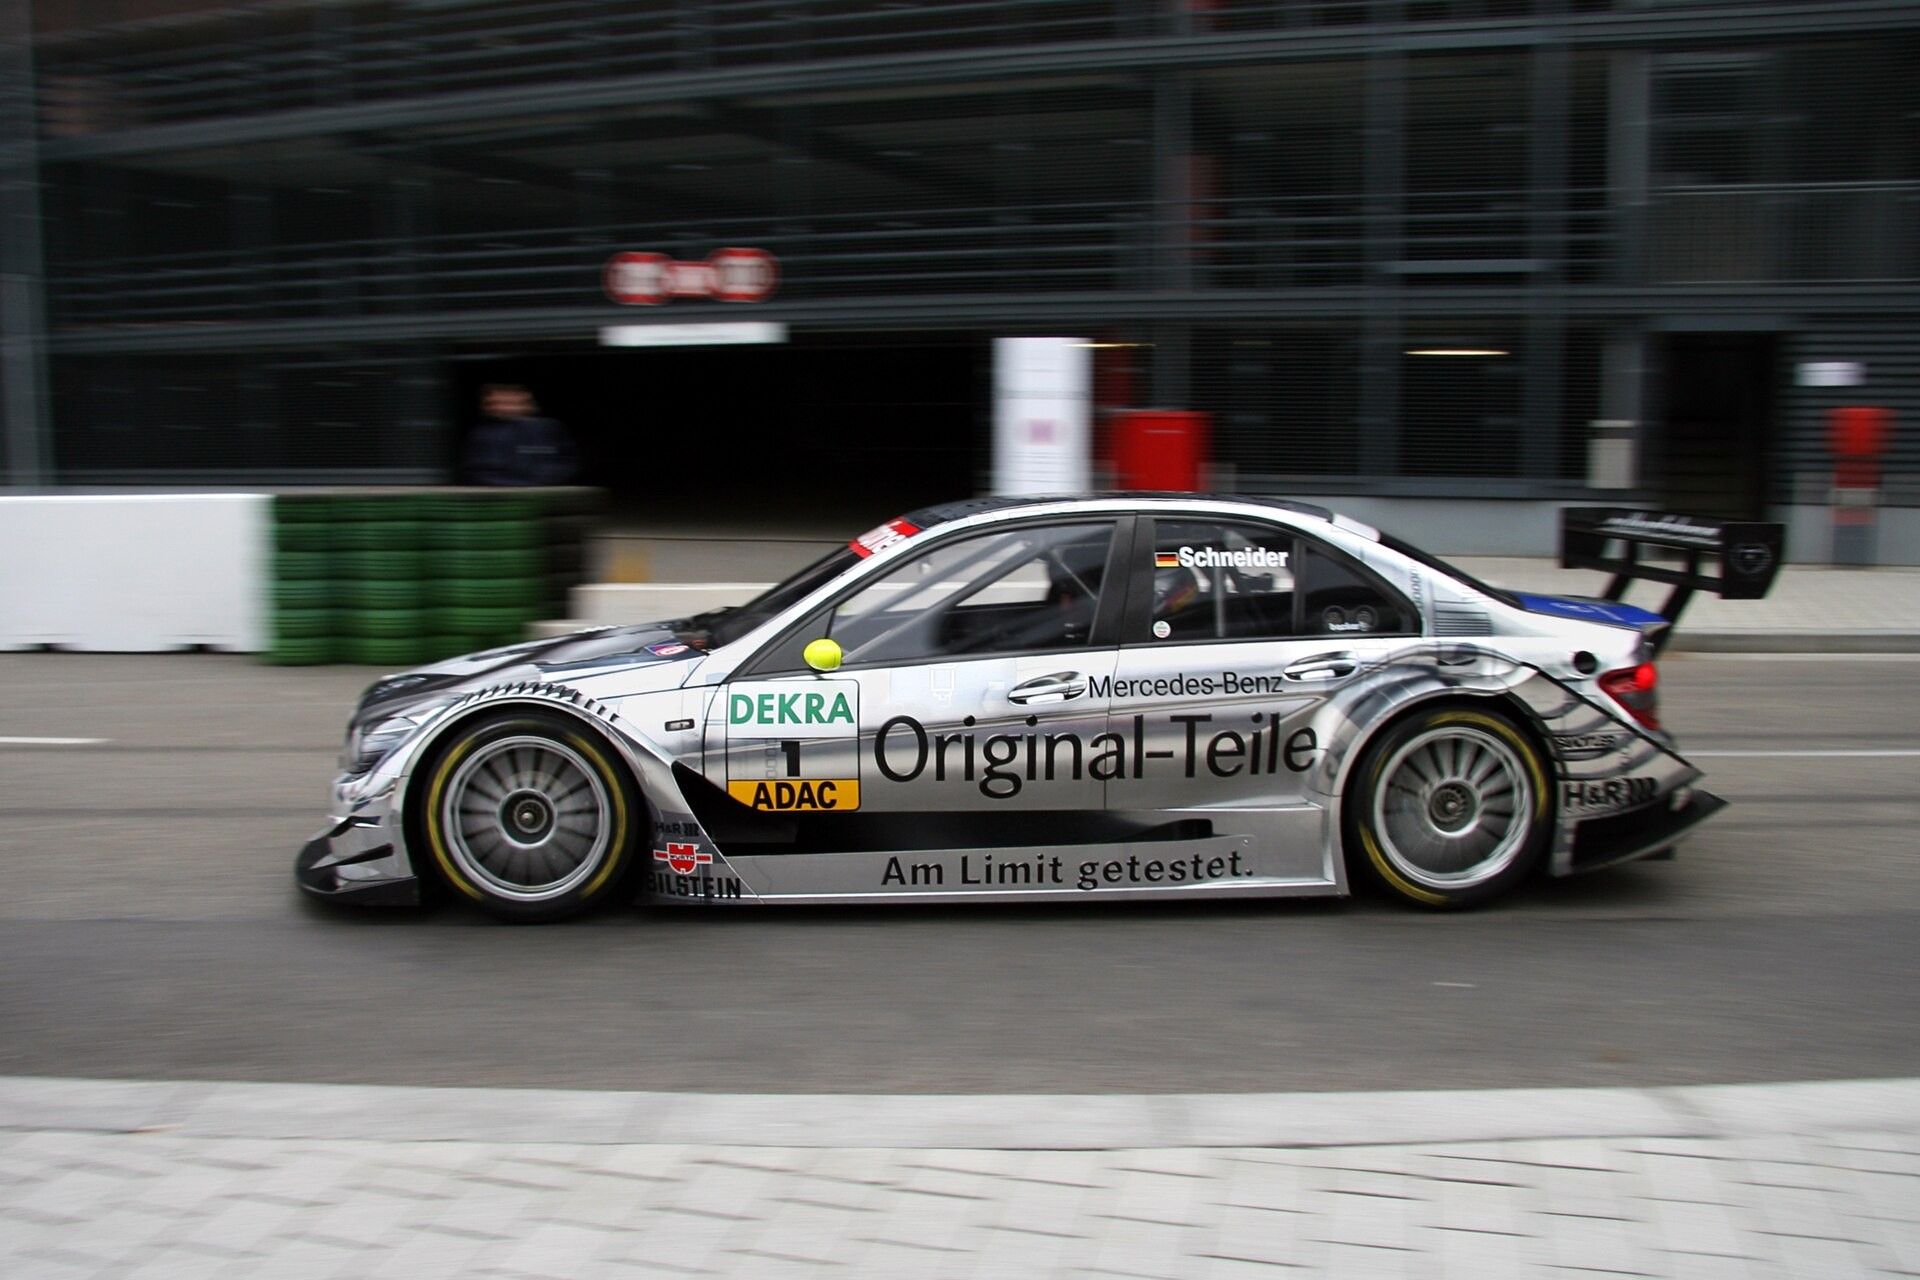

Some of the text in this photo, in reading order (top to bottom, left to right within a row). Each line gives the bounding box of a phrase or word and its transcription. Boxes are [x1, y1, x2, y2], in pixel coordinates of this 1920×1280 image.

[1179, 546, 1289, 568] Schneider
[1089, 671, 1283, 698] Mercedes-Benz
[731, 692, 855, 724] DEKRA
[781, 741, 800, 777] 1
[875, 713, 1317, 799] Original-Teile
[752, 781, 838, 810] ADAC
[1563, 781, 1621, 808] H&R
[655, 822, 682, 833] H&R
[881, 851, 1254, 891] Am Limit getestet.
[647, 872, 741, 899] BILSTEIN
